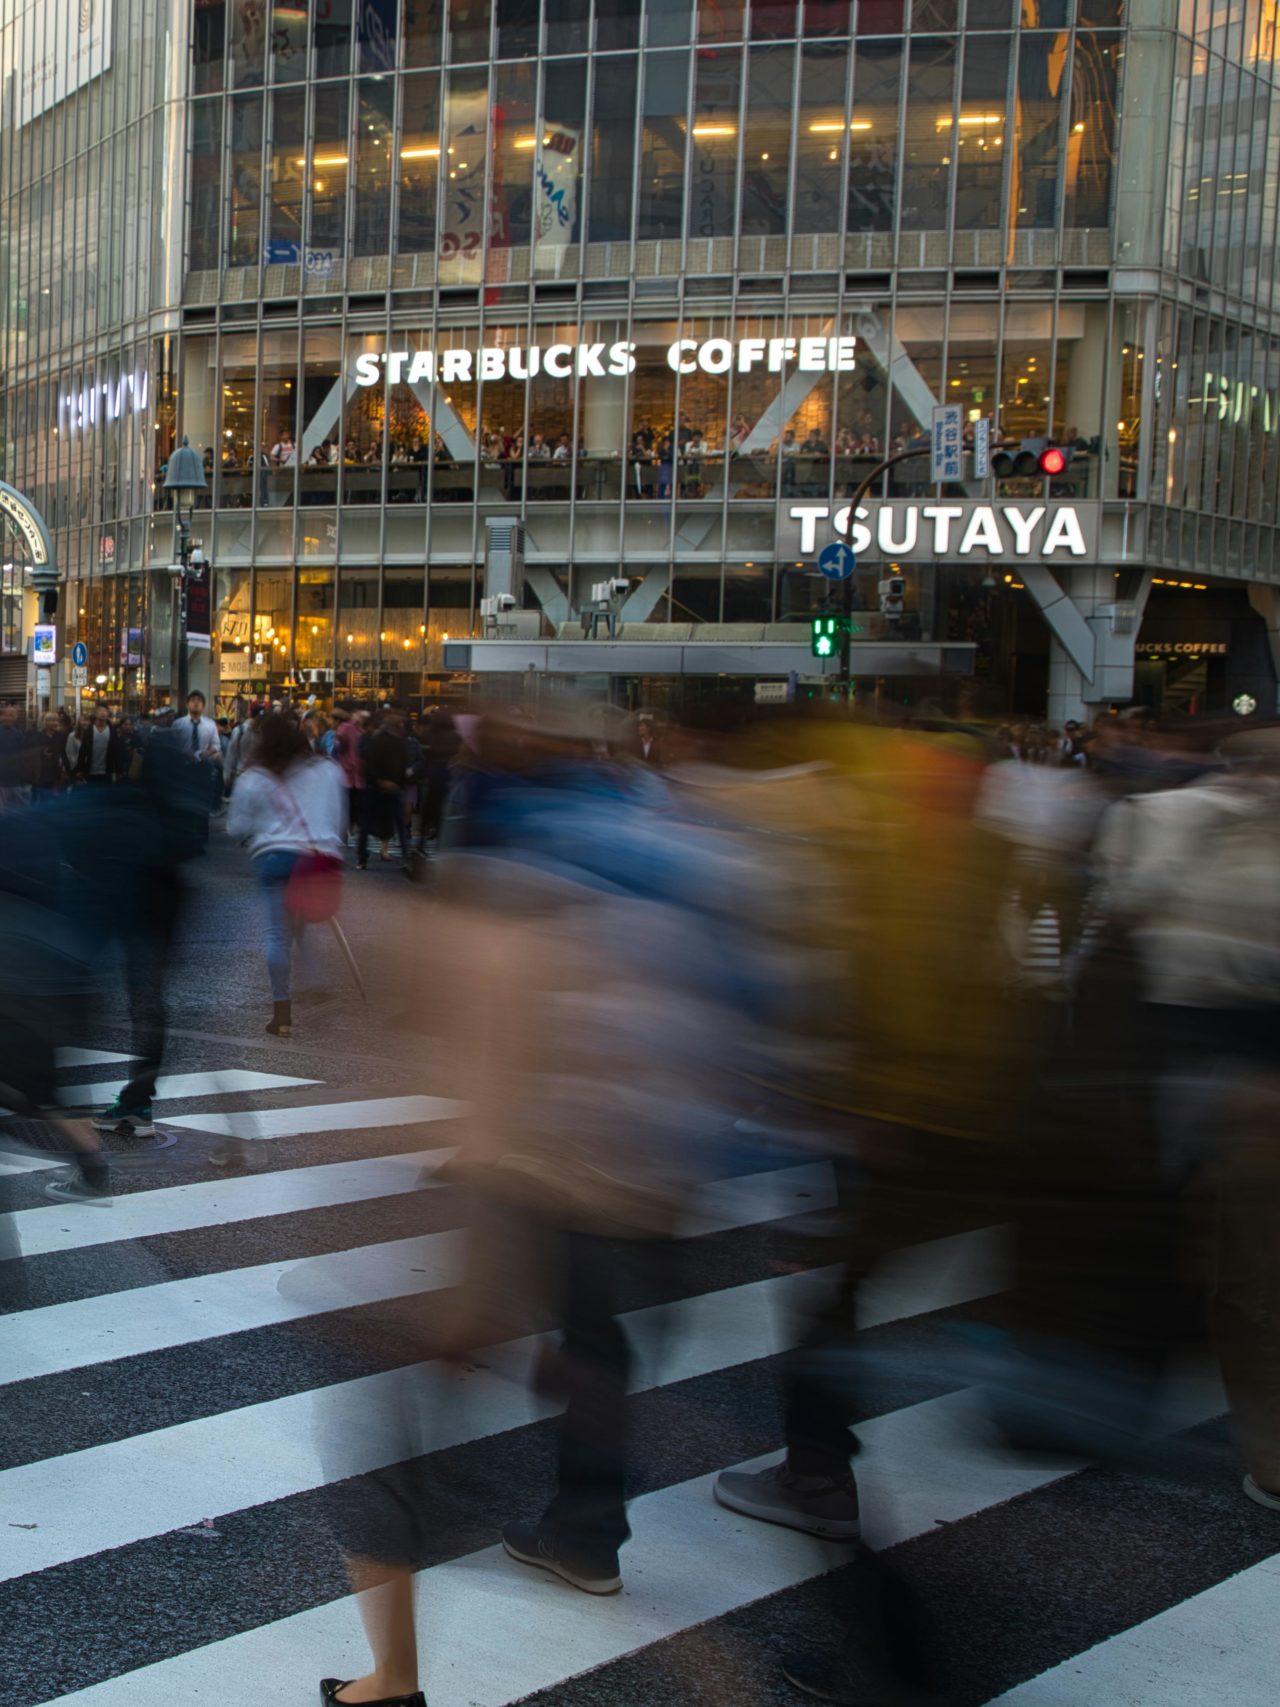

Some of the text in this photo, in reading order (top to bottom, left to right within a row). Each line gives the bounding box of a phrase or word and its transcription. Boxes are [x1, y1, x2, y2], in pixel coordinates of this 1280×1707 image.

[355, 336, 857, 387] STARBUCKS COFFEE
[945, 411, 959, 476] 渋谷駅前
[789, 505, 1088, 556] TSUTAYA
[343, 659, 399, 671] COFFEE
[1174, 642, 1228, 654] COFFEE
